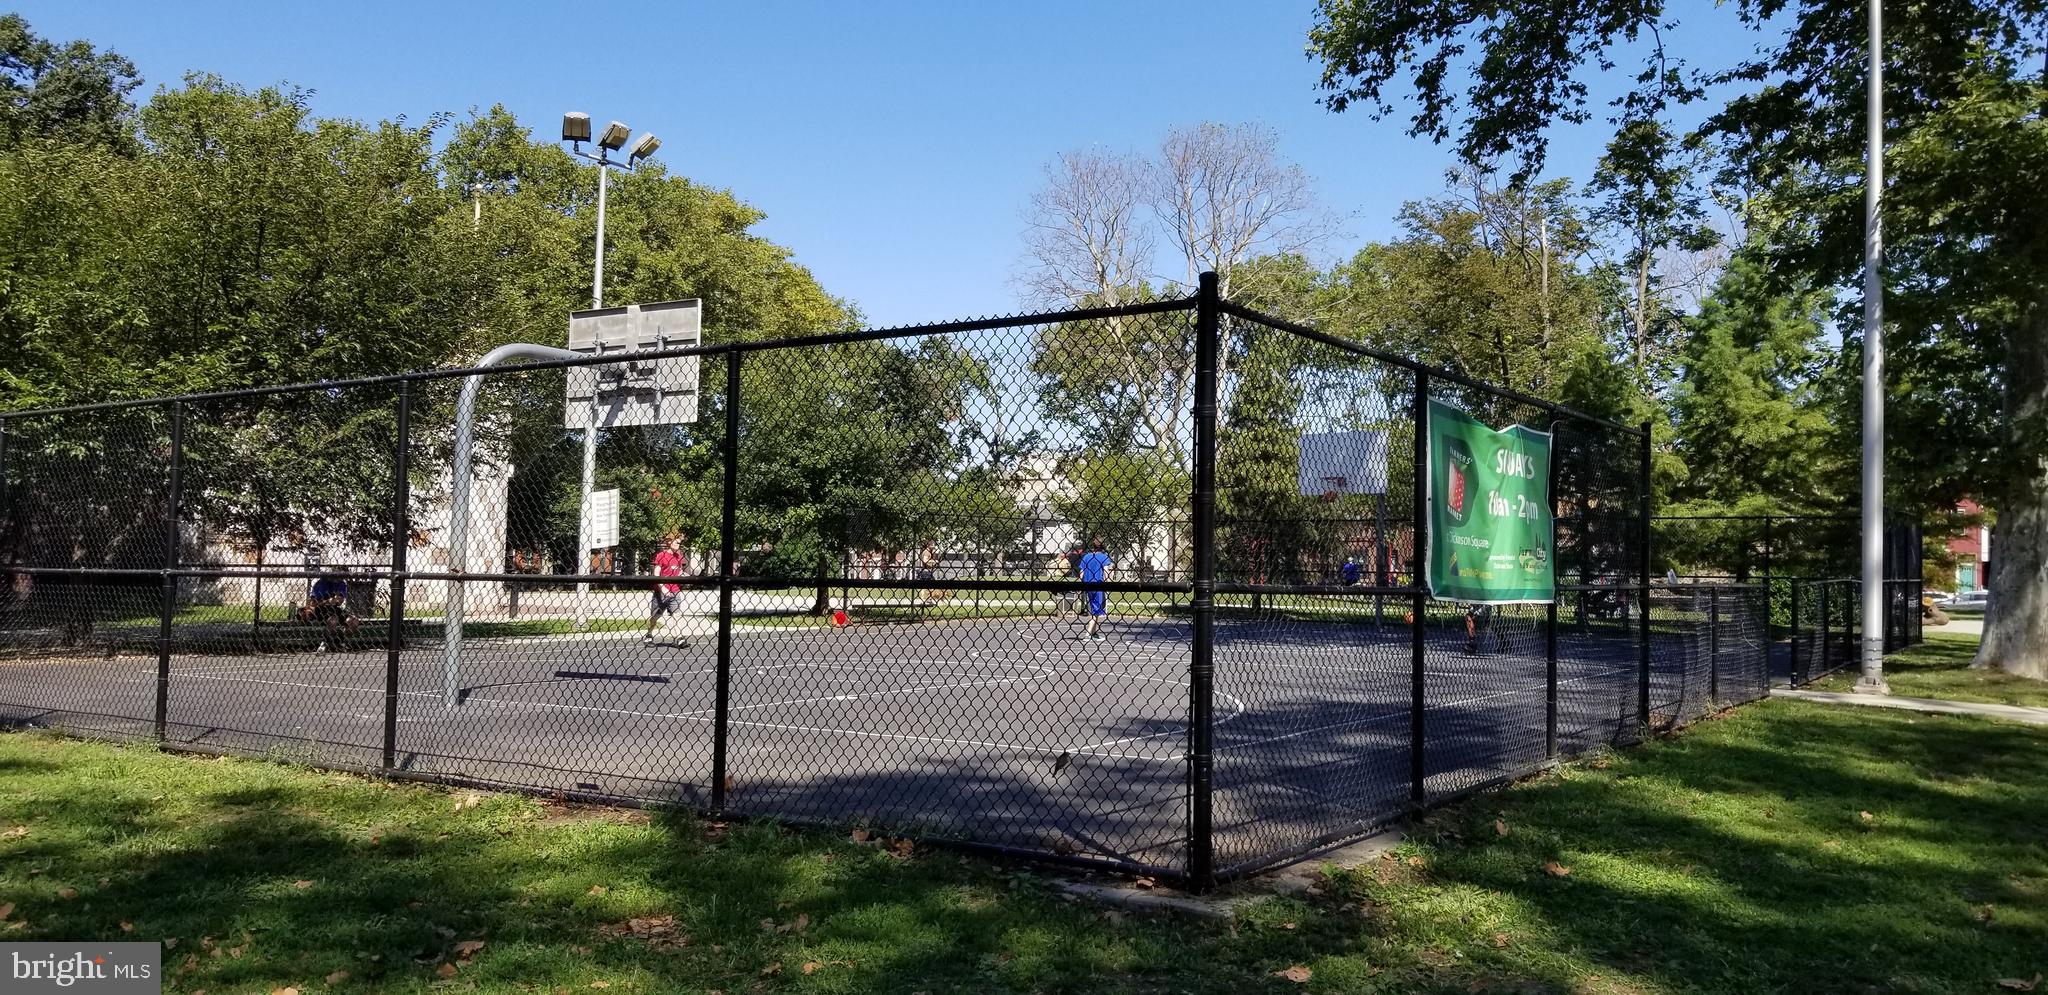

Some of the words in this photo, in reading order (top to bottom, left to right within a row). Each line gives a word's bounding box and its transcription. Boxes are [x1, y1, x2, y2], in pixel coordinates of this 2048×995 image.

[1496, 449, 1534, 479] SDAYS
[1518, 494, 1538, 524] 2pm
[1471, 535, 1489, 549] Square
